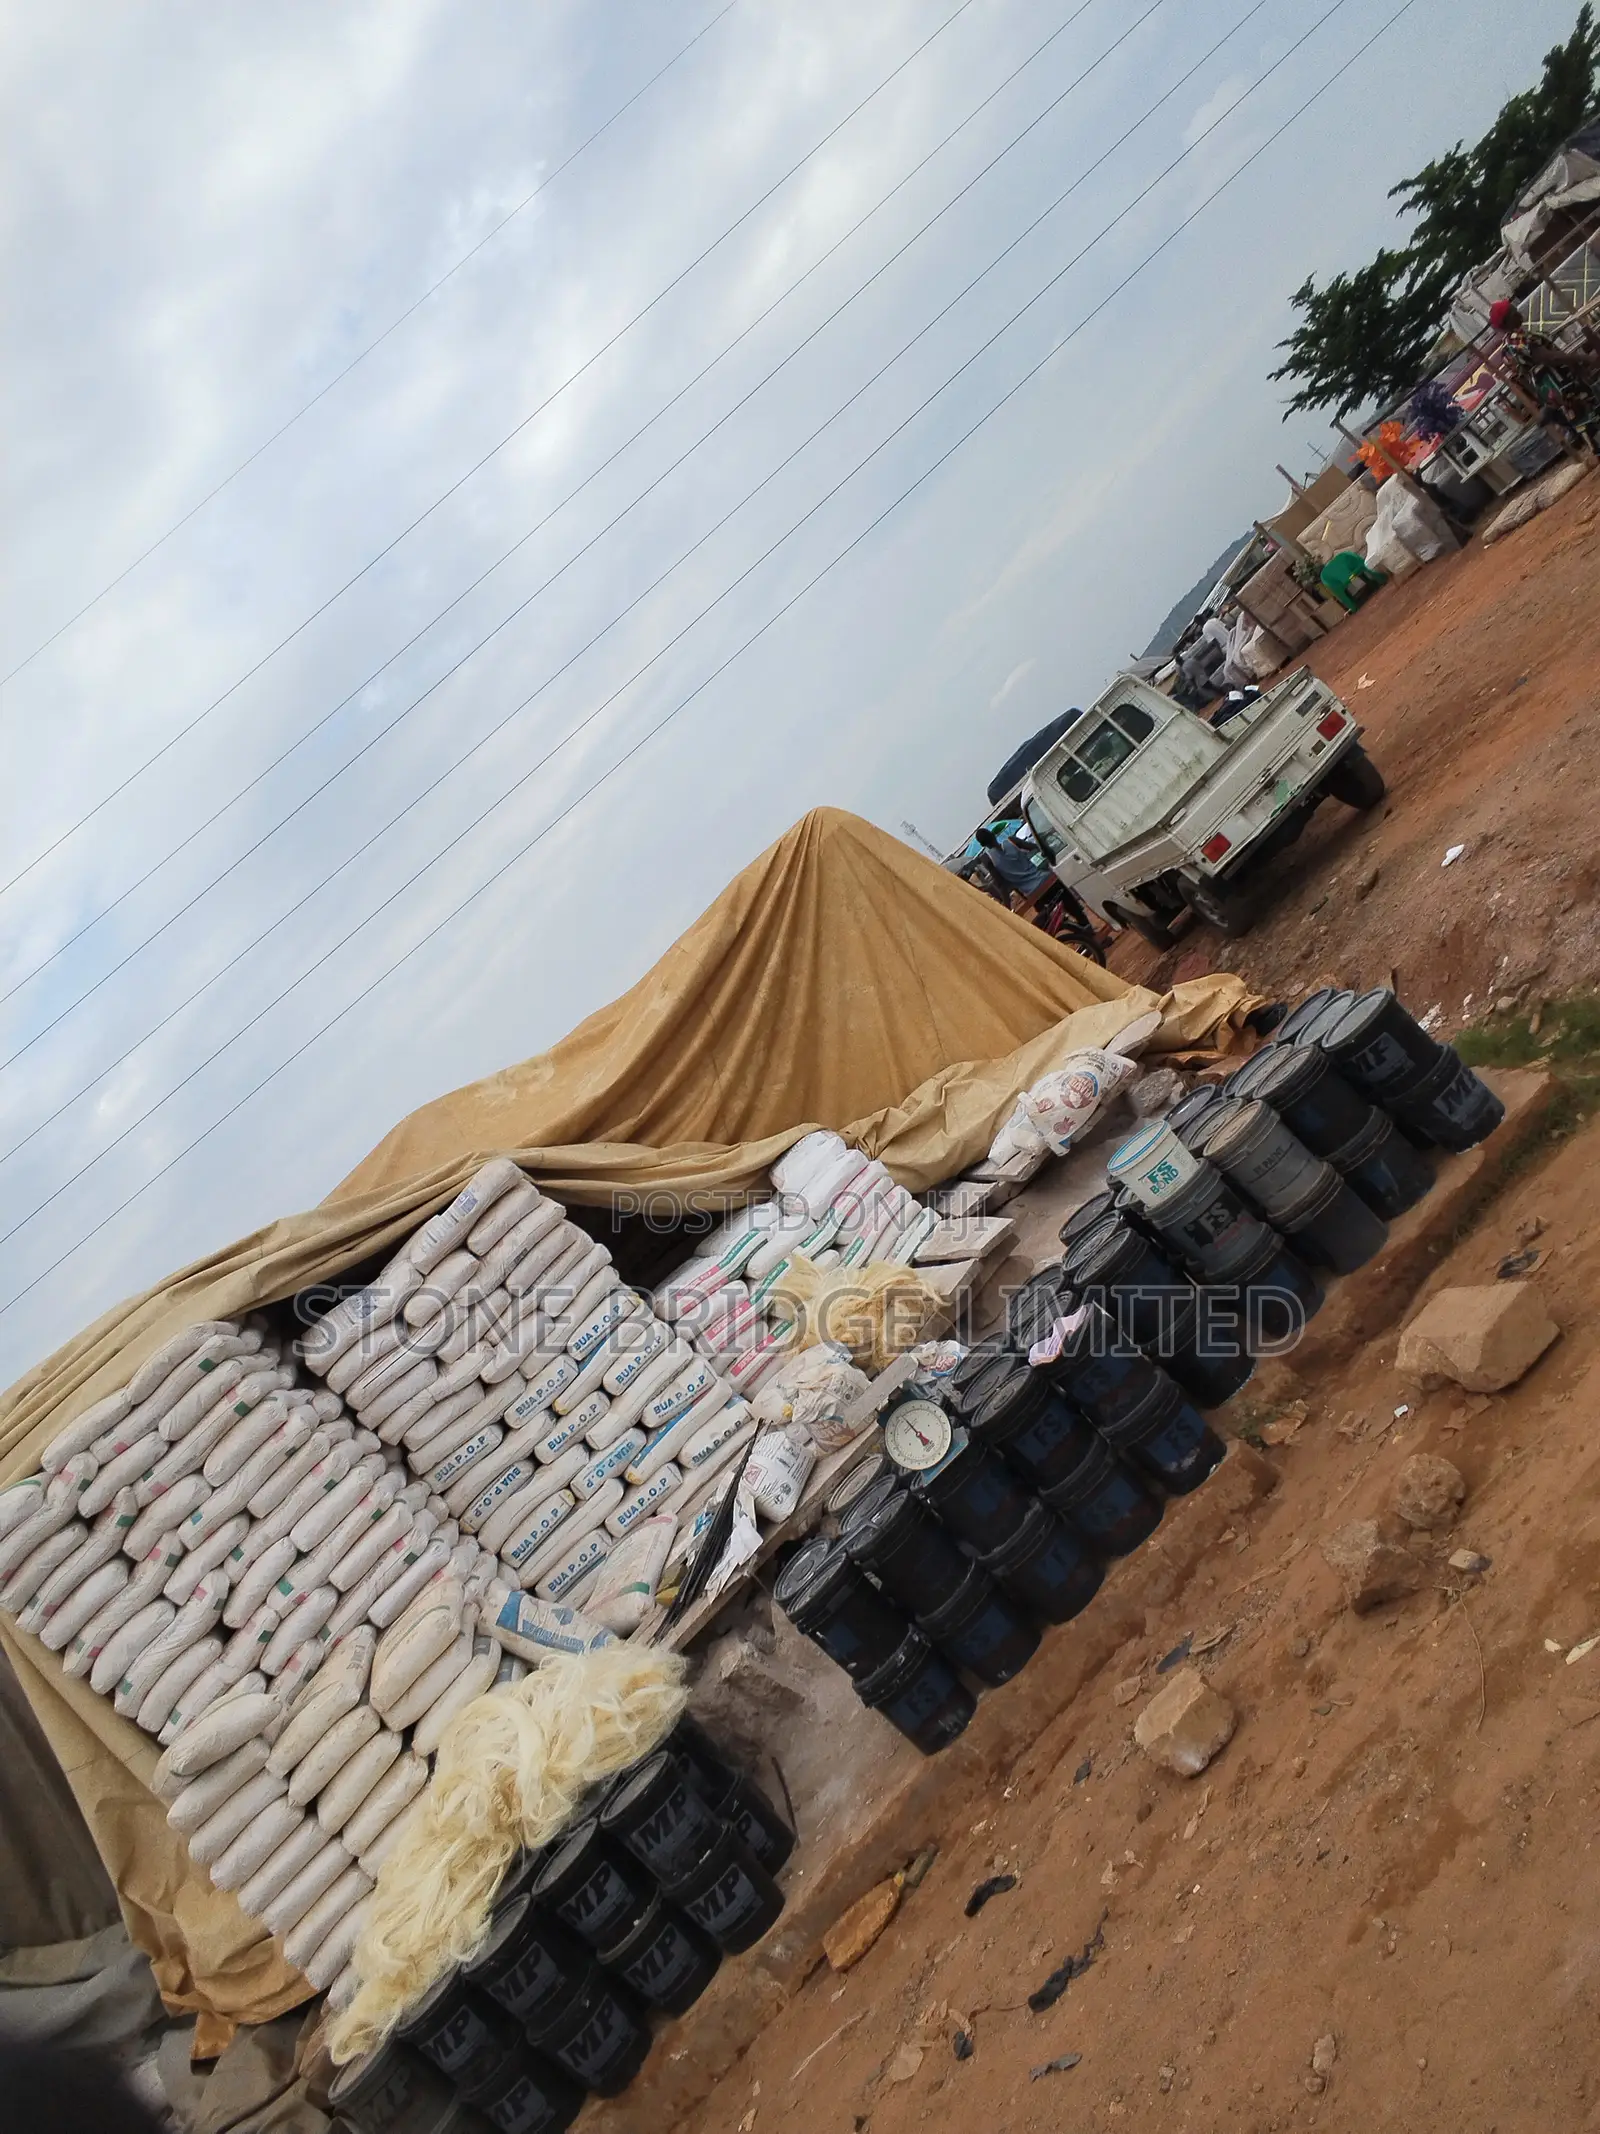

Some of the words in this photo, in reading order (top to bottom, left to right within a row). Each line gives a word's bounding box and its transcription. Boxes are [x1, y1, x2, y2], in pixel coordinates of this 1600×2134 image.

[1147, 1161, 1173, 1184] FS
[1149, 1168, 1179, 1195] BOND
[1200, 1201, 1231, 1232] FS
[572, 1332, 594, 1351] BUA
[615, 1364, 636, 1384] BUA
[515, 1396, 537, 1416] BUA
[653, 1398, 674, 1415] BUA
[547, 1431, 569, 1450] BUA
[1032, 1413, 1063, 1446] FS
[613, 1441, 635, 1460] BUA
[692, 1446, 714, 1464] BUA
[434, 1462, 456, 1482] BUA
[501, 1467, 521, 1487] BUA
[617, 1504, 639, 1526] BUA
[511, 1539, 532, 1560] BUA
[547, 1572, 570, 1592] BUA
[638, 1787, 687, 1847] MP
[563, 1864, 611, 1920] MP
[691, 1867, 739, 1923] MP
[627, 1925, 678, 1981] MP
[490, 1945, 542, 2001] MP
[422, 2008, 471, 2061] MP
[565, 2001, 618, 2069] MP
